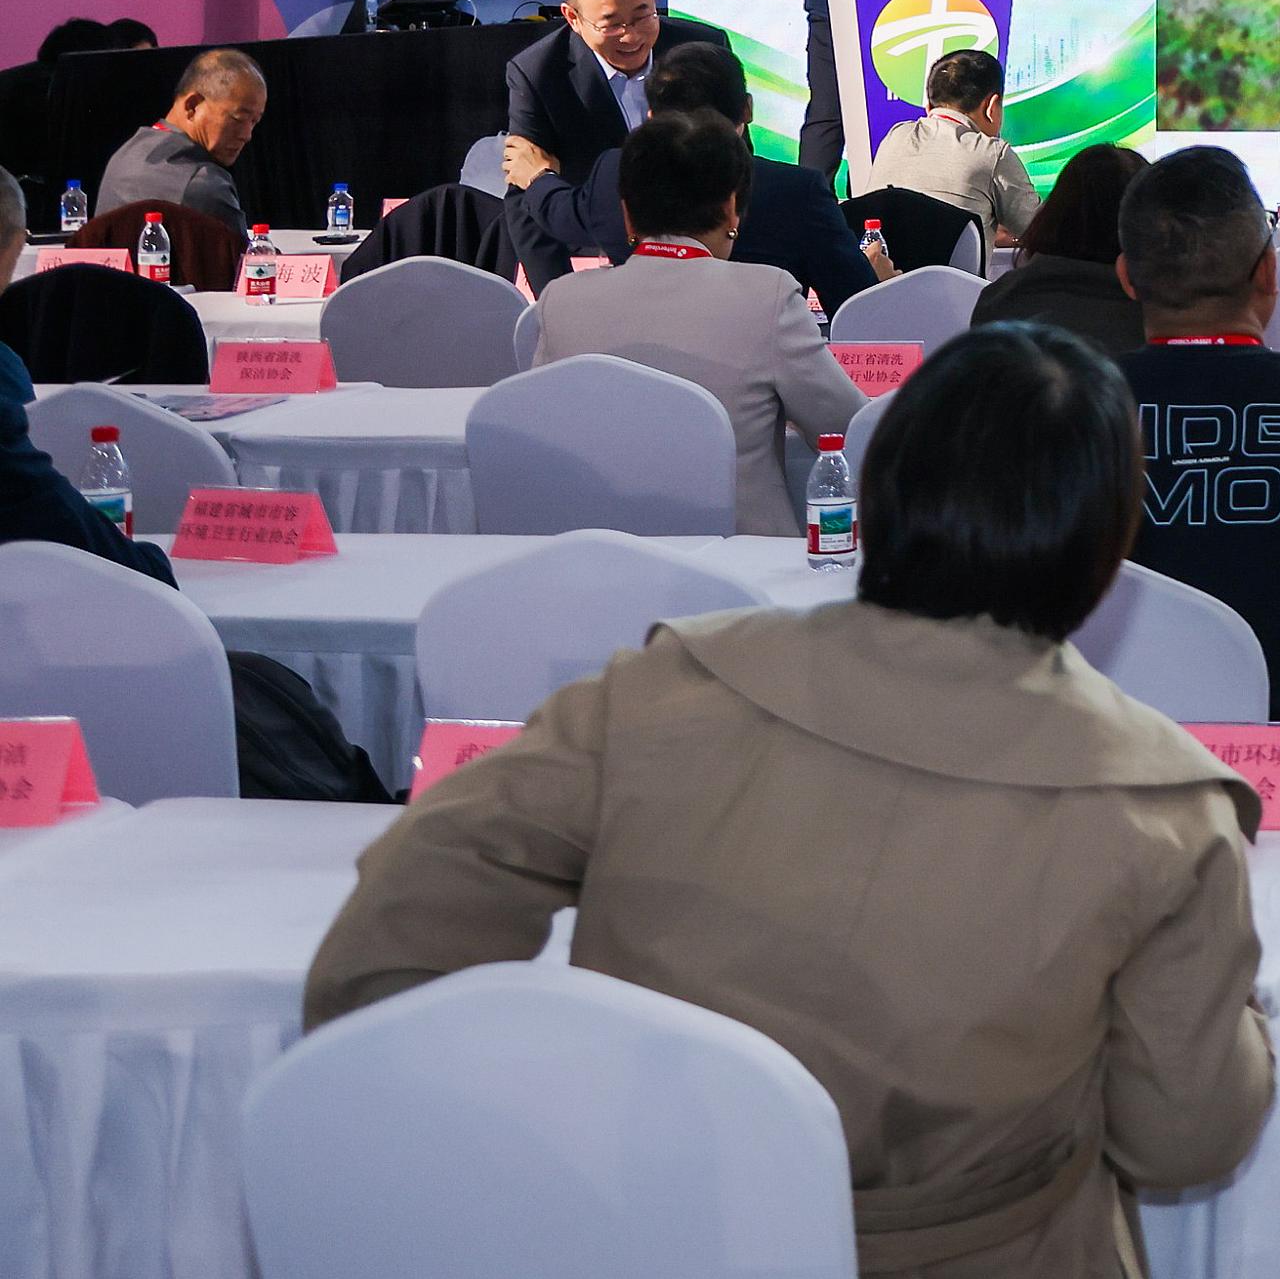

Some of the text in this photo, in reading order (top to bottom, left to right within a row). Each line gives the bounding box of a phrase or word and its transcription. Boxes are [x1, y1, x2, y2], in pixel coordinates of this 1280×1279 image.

[833, 352, 904, 366] 龙江省清洗
